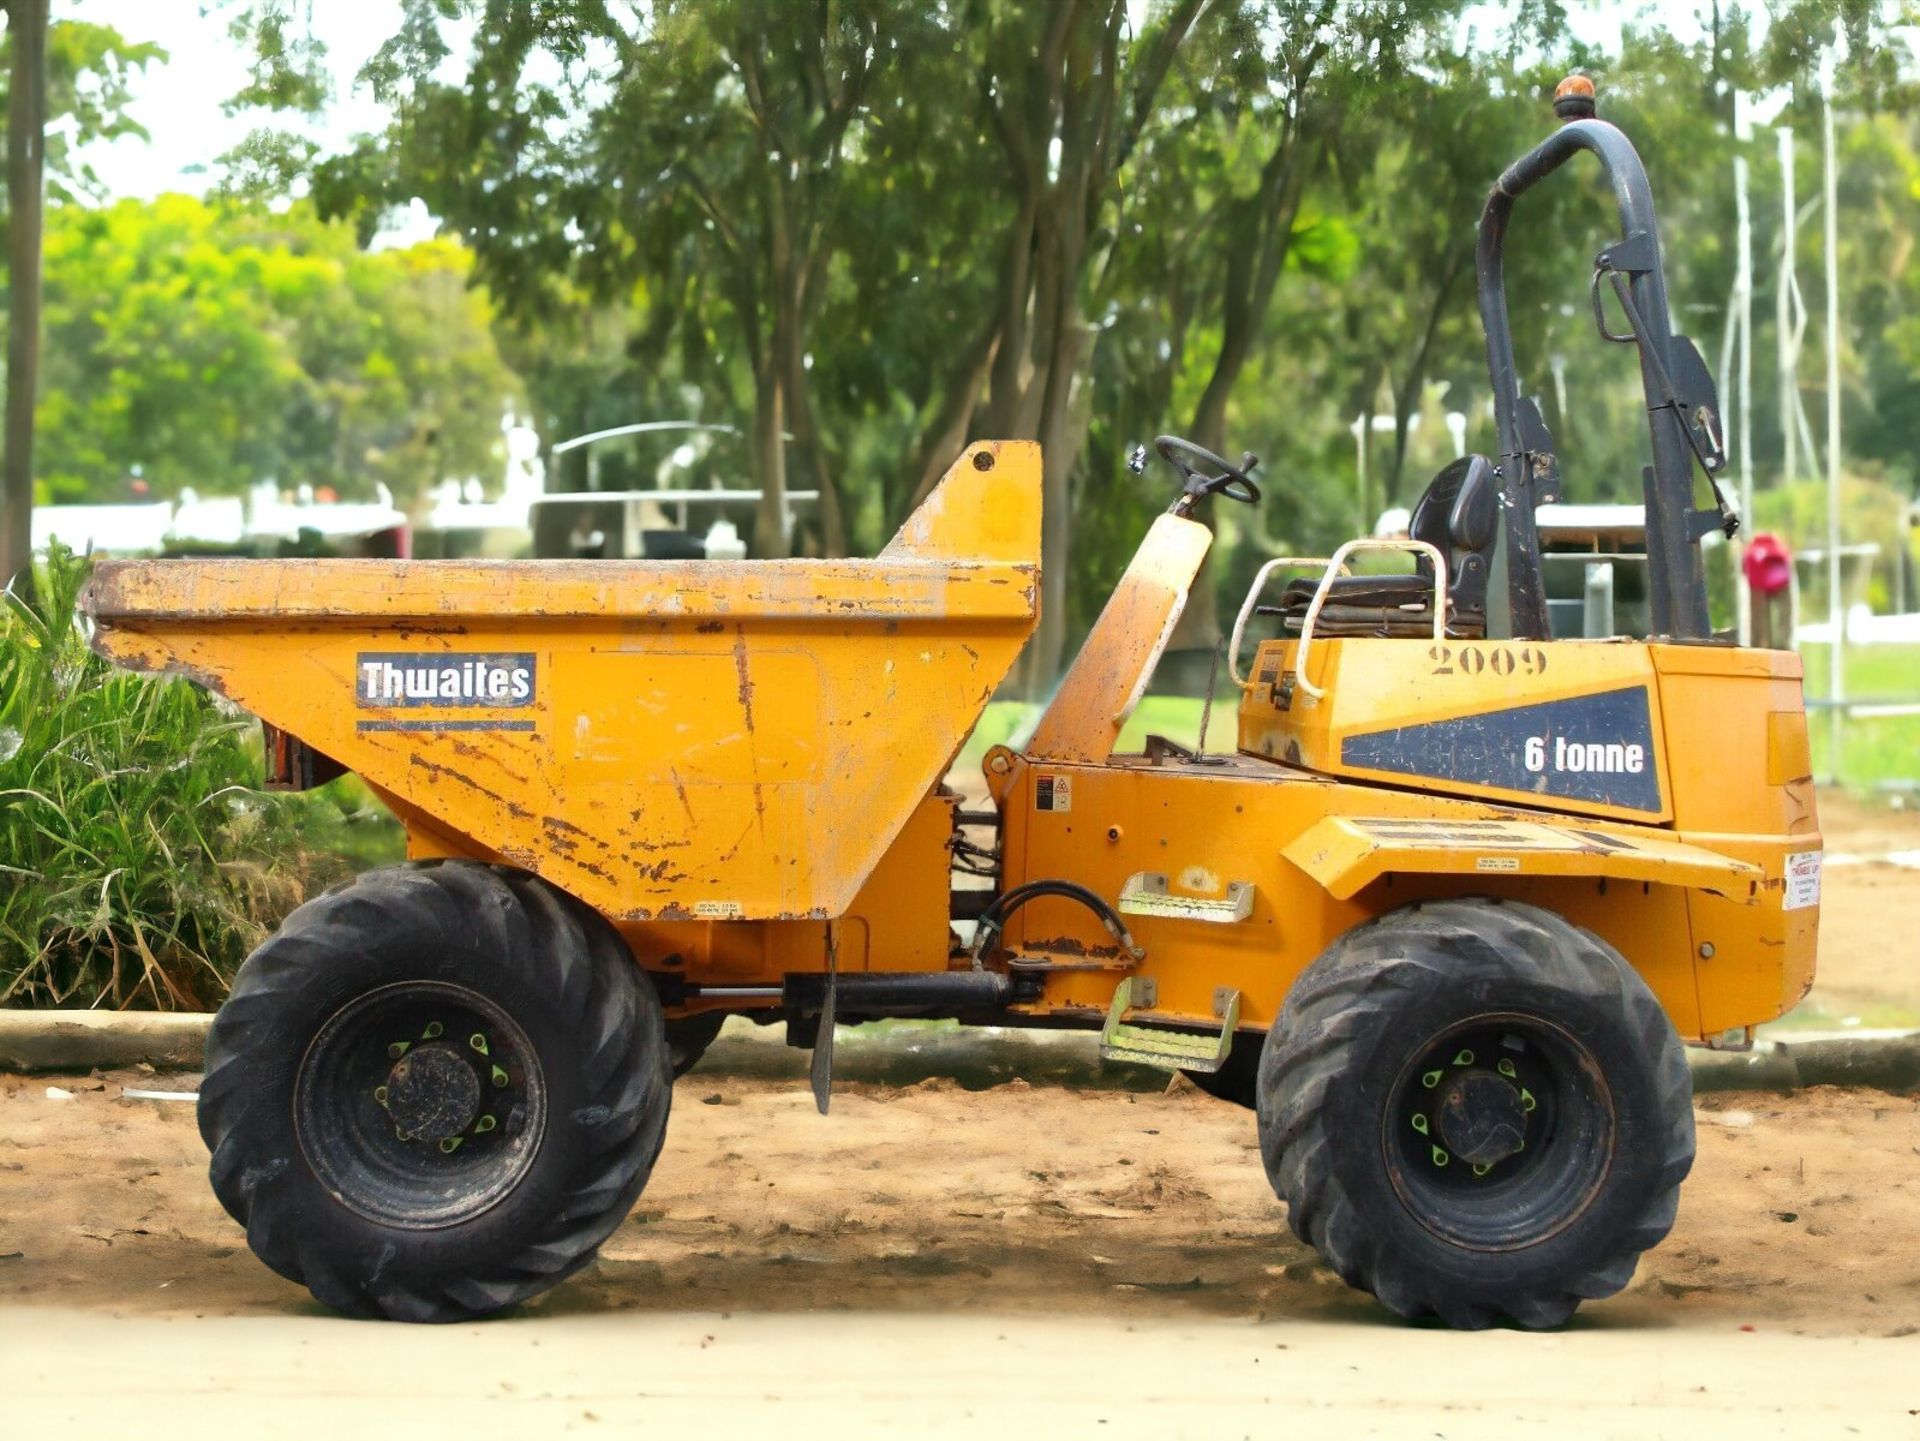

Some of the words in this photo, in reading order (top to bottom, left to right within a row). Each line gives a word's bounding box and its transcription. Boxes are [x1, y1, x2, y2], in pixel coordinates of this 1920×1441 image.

[1429, 646, 1546, 676] 2009
[363, 662, 530, 699] Thwaites
[1525, 736, 1545, 772] 6
[1555, 736, 1643, 772] tonne
